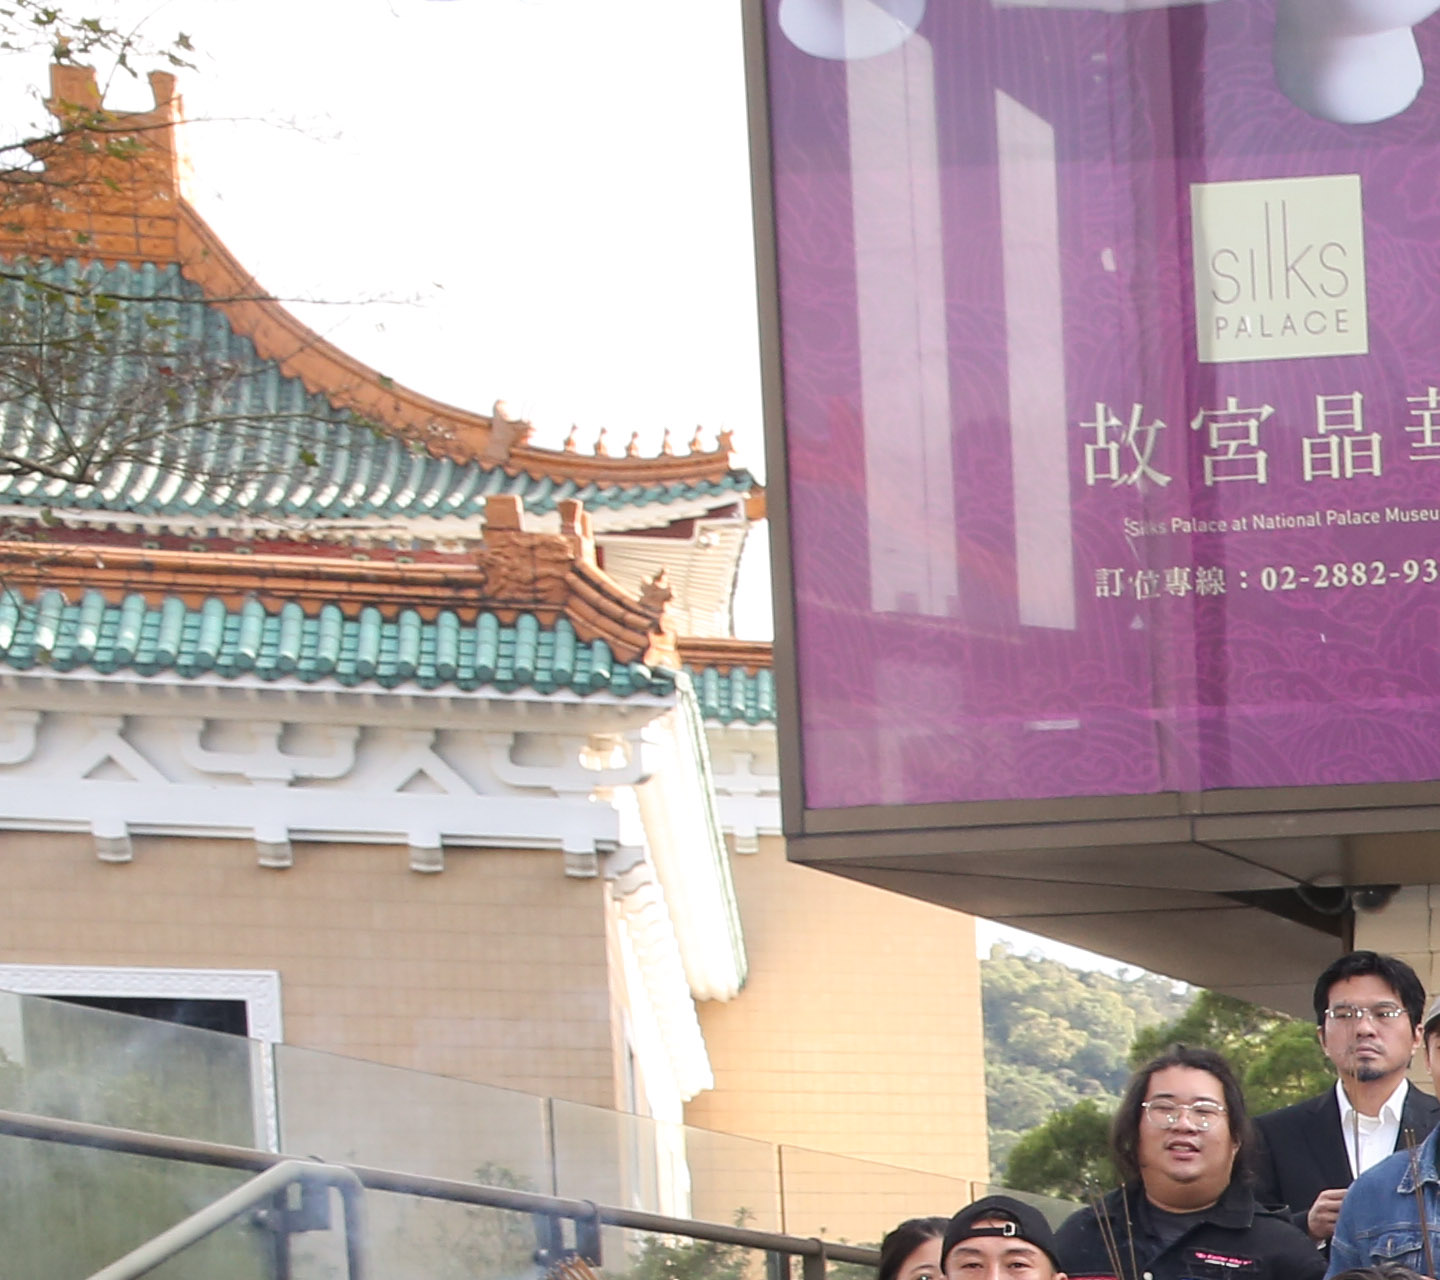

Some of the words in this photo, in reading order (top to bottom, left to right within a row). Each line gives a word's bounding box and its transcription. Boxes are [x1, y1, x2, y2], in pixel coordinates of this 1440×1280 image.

[1215, 309, 1349, 340] PALACE
[1171, 516, 1227, 535] Palace
[1232, 517, 1248, 532] at
[1253, 511, 1321, 531] National
[1327, 509, 1380, 526] Palace
